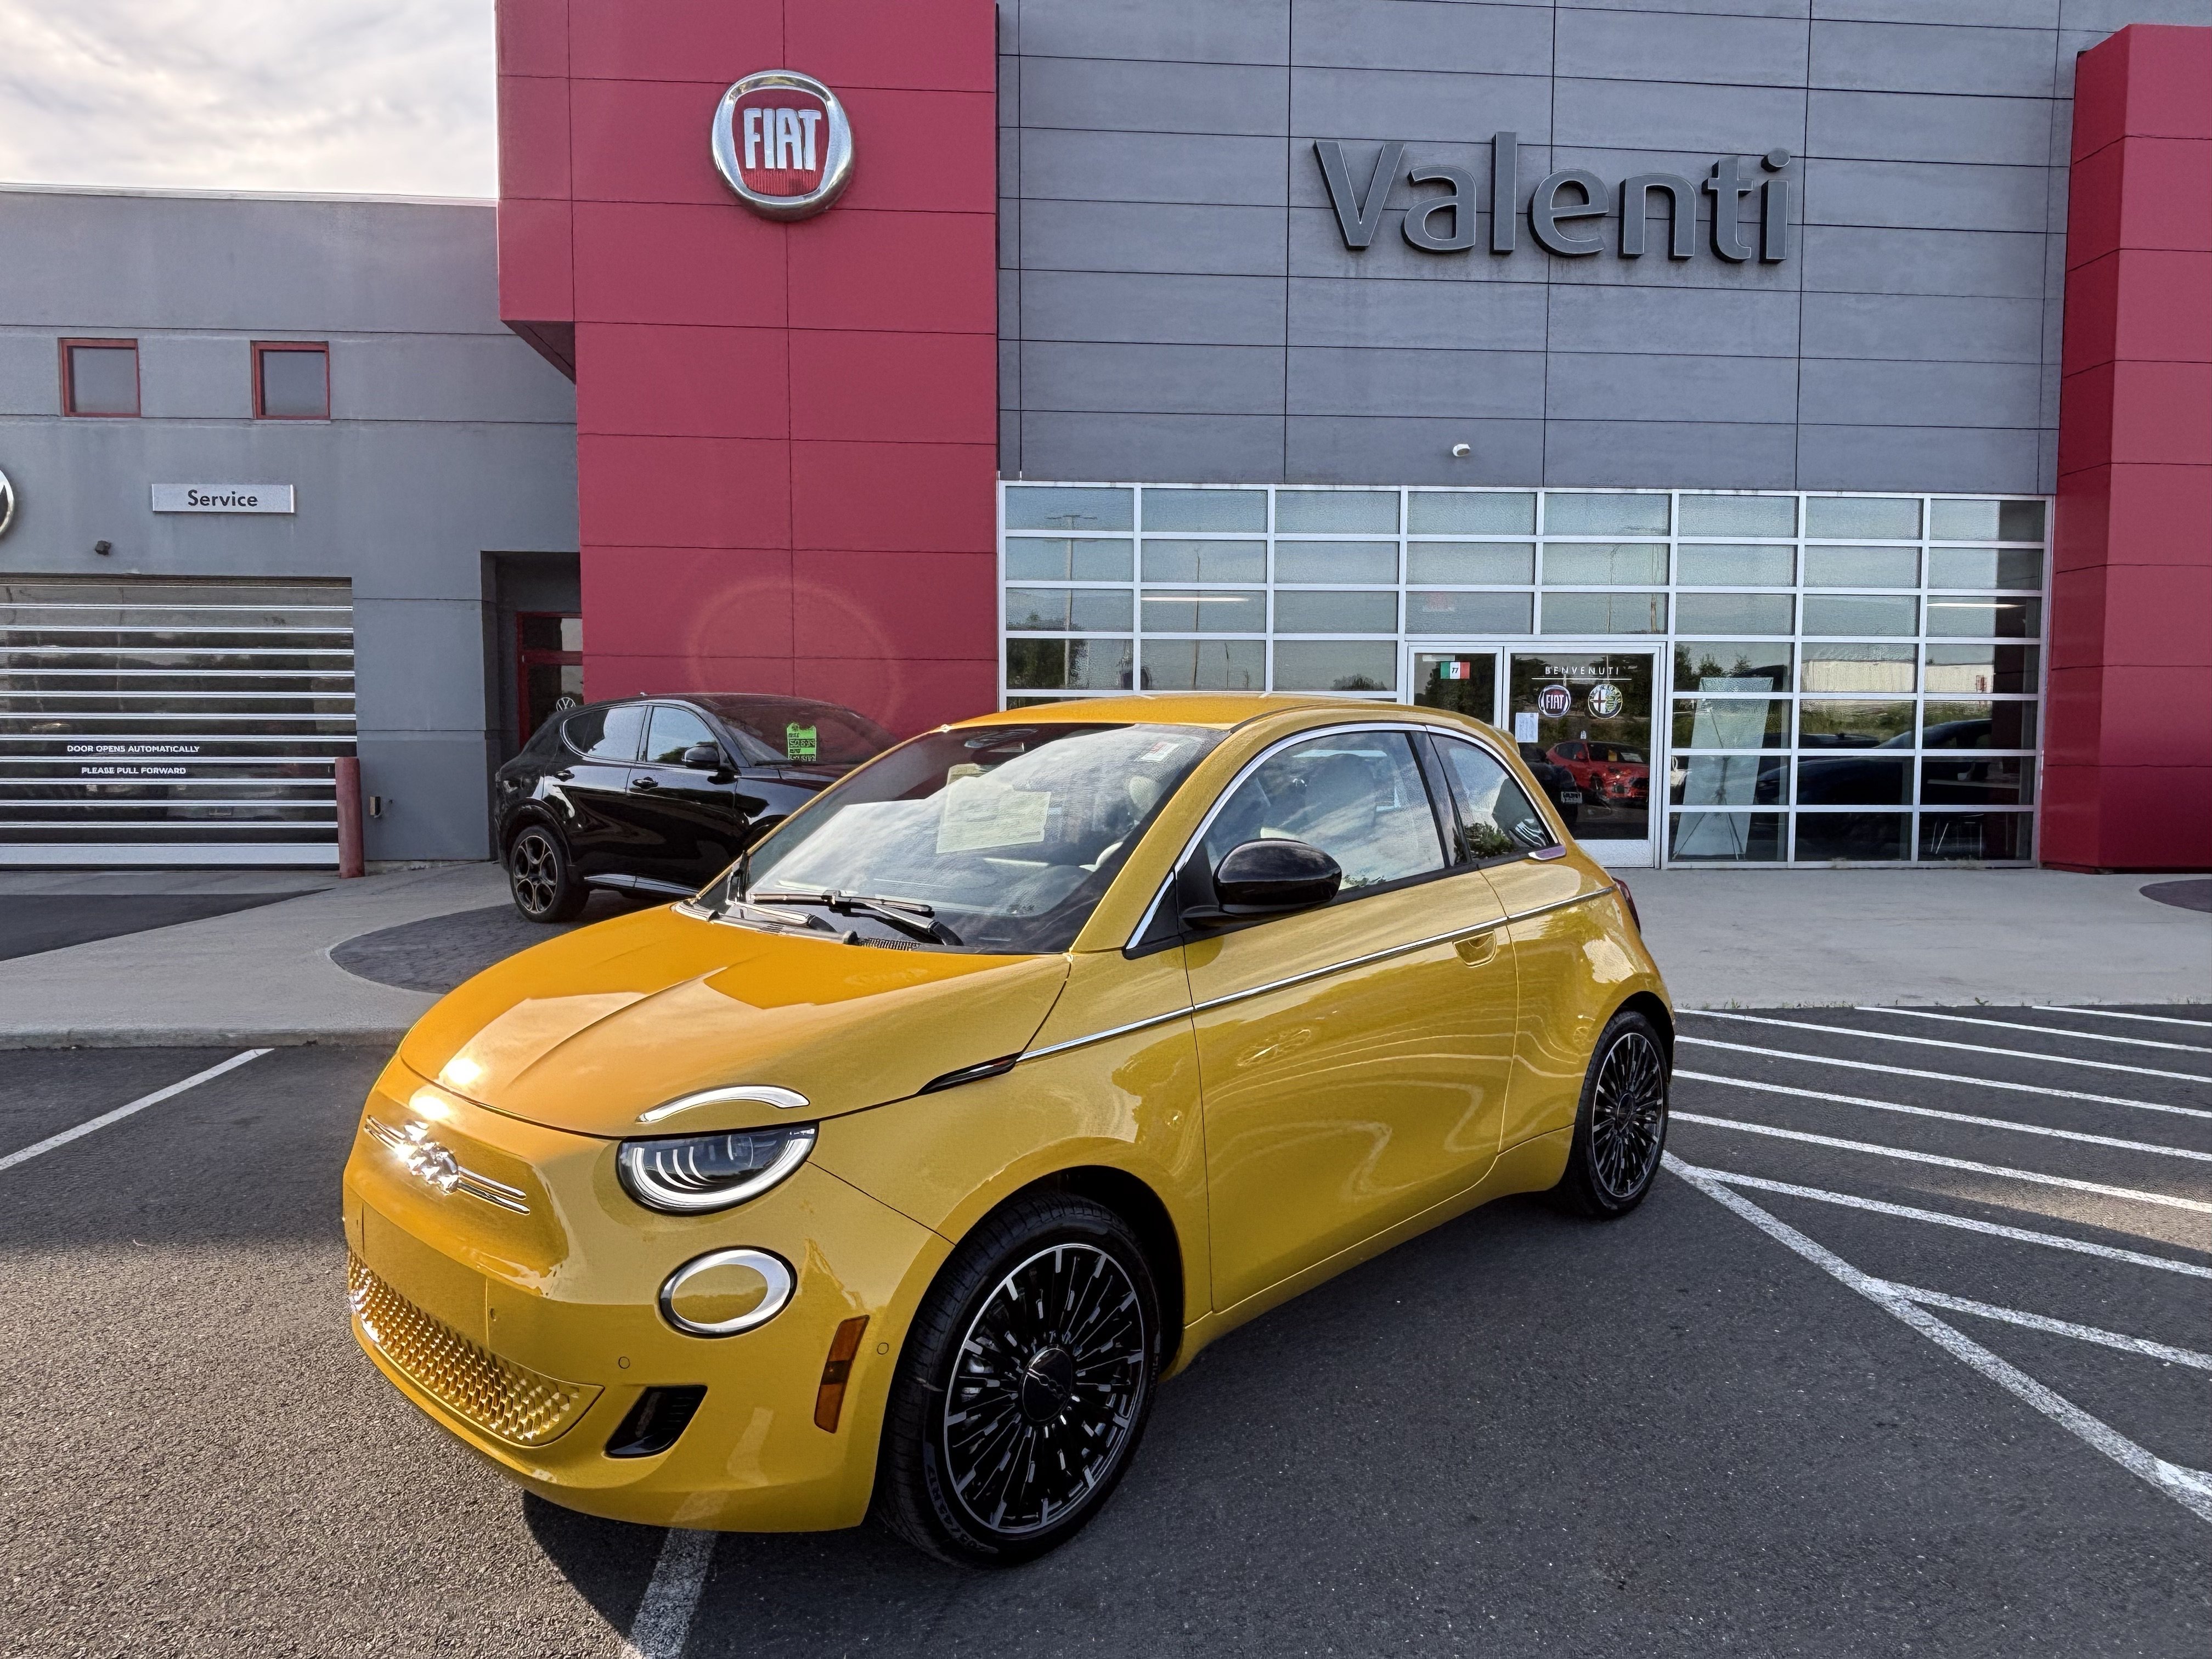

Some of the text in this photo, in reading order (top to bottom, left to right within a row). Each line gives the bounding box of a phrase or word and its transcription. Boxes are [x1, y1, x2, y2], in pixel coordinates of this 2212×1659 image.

[743, 108, 822, 171] FIAT
[1313, 132, 1791, 263] Valenti
[188, 489, 258, 507] Service
[1545, 666, 1619, 675] BENVENUTI
[1545, 694, 1565, 710] FIAT
